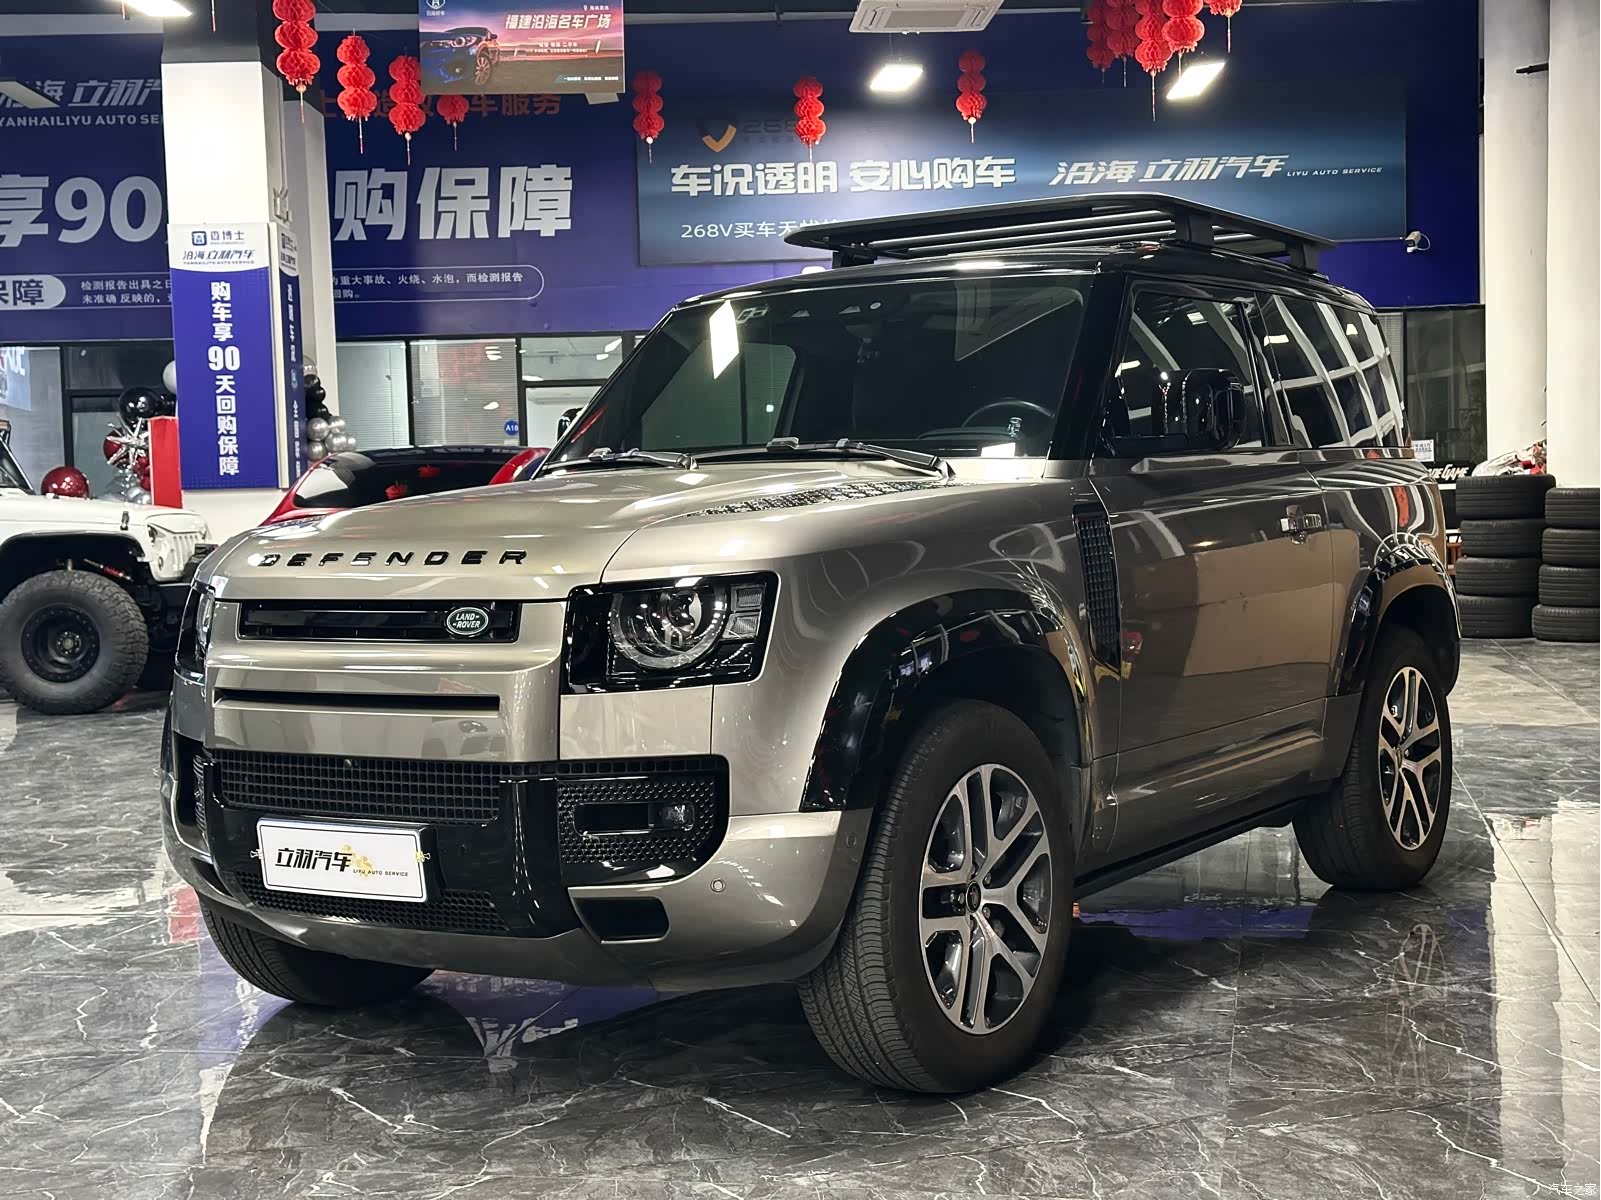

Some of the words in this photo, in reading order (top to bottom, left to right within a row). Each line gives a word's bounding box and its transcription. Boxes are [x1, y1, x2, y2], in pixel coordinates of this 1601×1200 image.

[505, 14, 611, 29] 福建沿海名车广场
[0, 79, 66, 108] 海
[95, 114, 137, 125] AUTO
[670, 161, 839, 197] 车况透明
[849, 156, 1017, 193] 安心购车
[1342, 167, 1383, 175] SERVICE
[334, 164, 573, 241] 购保障
[0, 278, 45, 306] 障
[258, 550, 527, 567] DEFENDER
[275, 848, 352, 872] 立羽汽车
